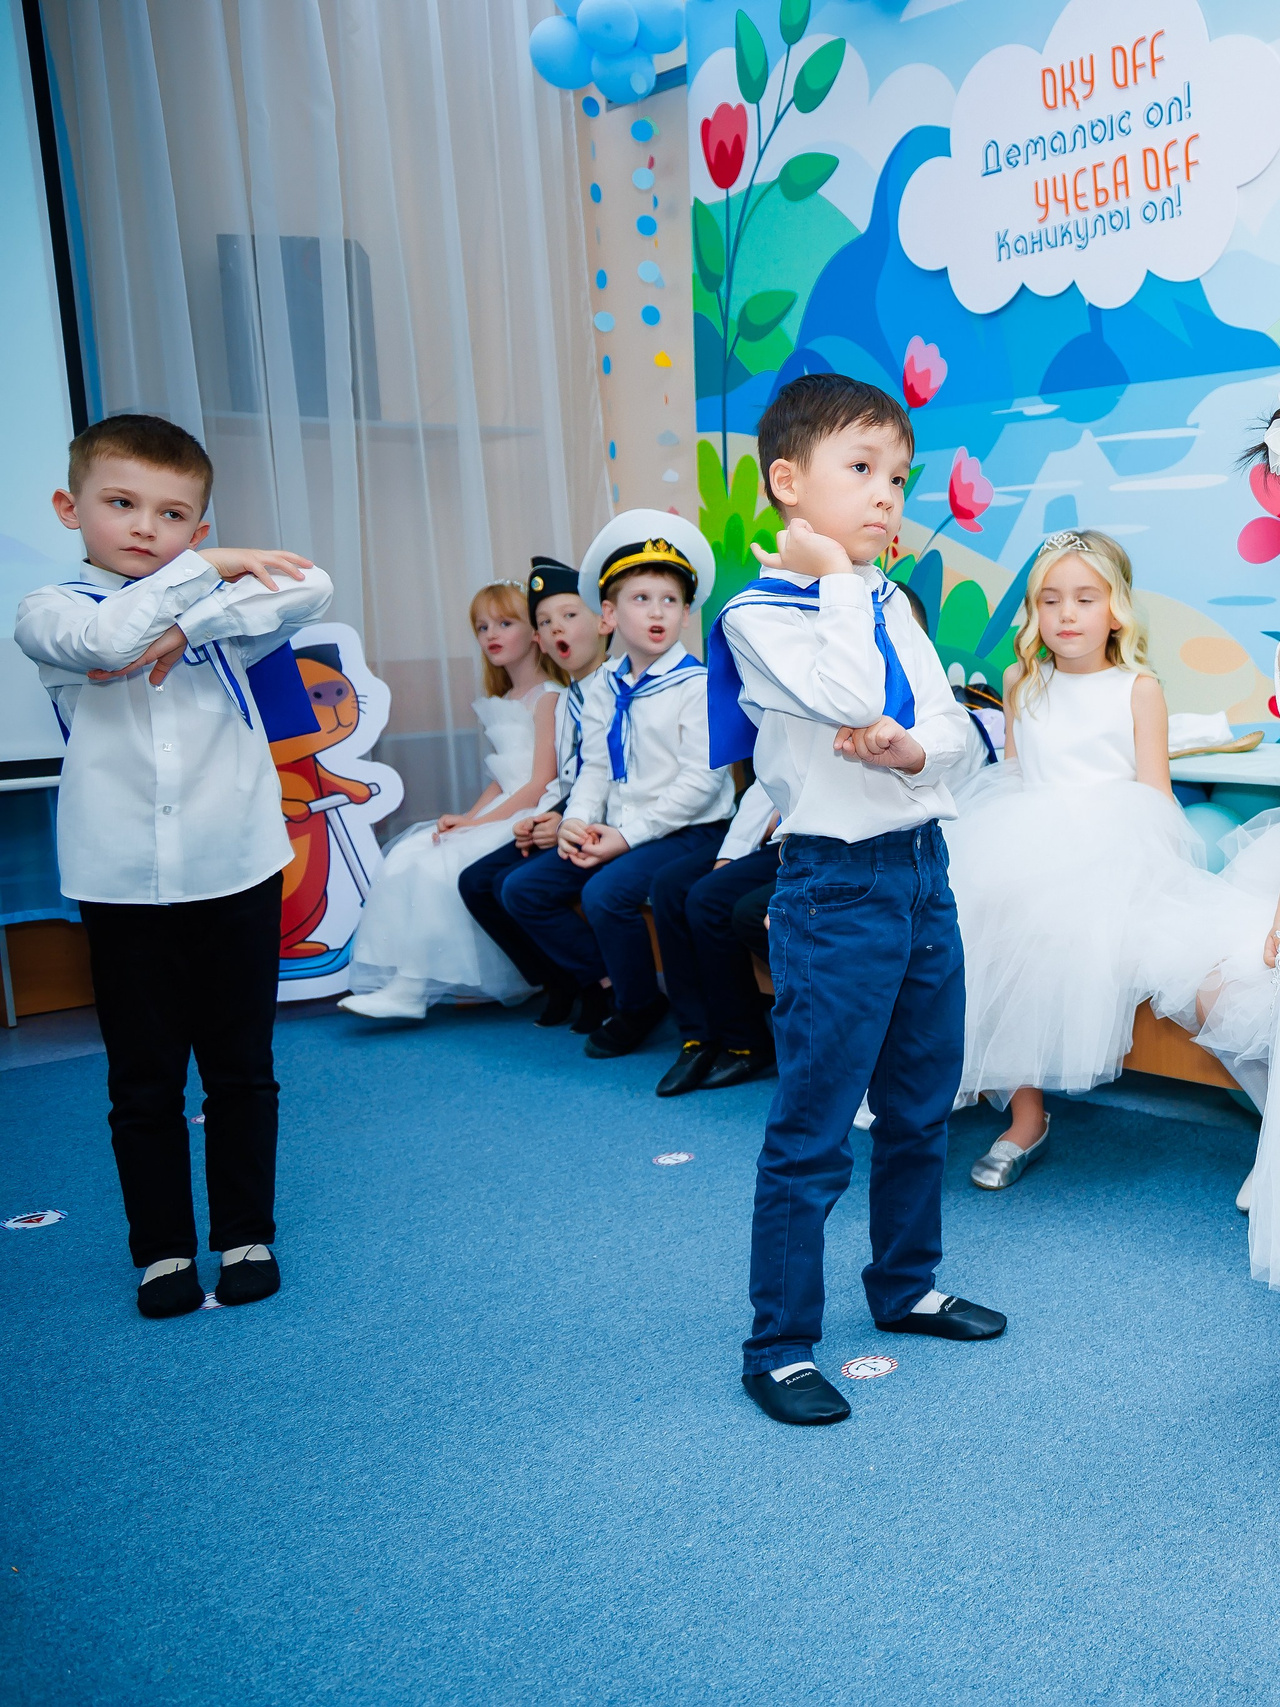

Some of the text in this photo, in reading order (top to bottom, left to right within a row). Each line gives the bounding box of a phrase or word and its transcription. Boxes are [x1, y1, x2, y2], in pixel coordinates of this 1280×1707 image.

[1041, 29, 1165, 110] ОҚУ OFF
[981, 110, 1133, 177] Демалыс
[1034, 133, 1200, 223] УЧЕБА OFF
[995, 206, 1130, 262] Каникулы
